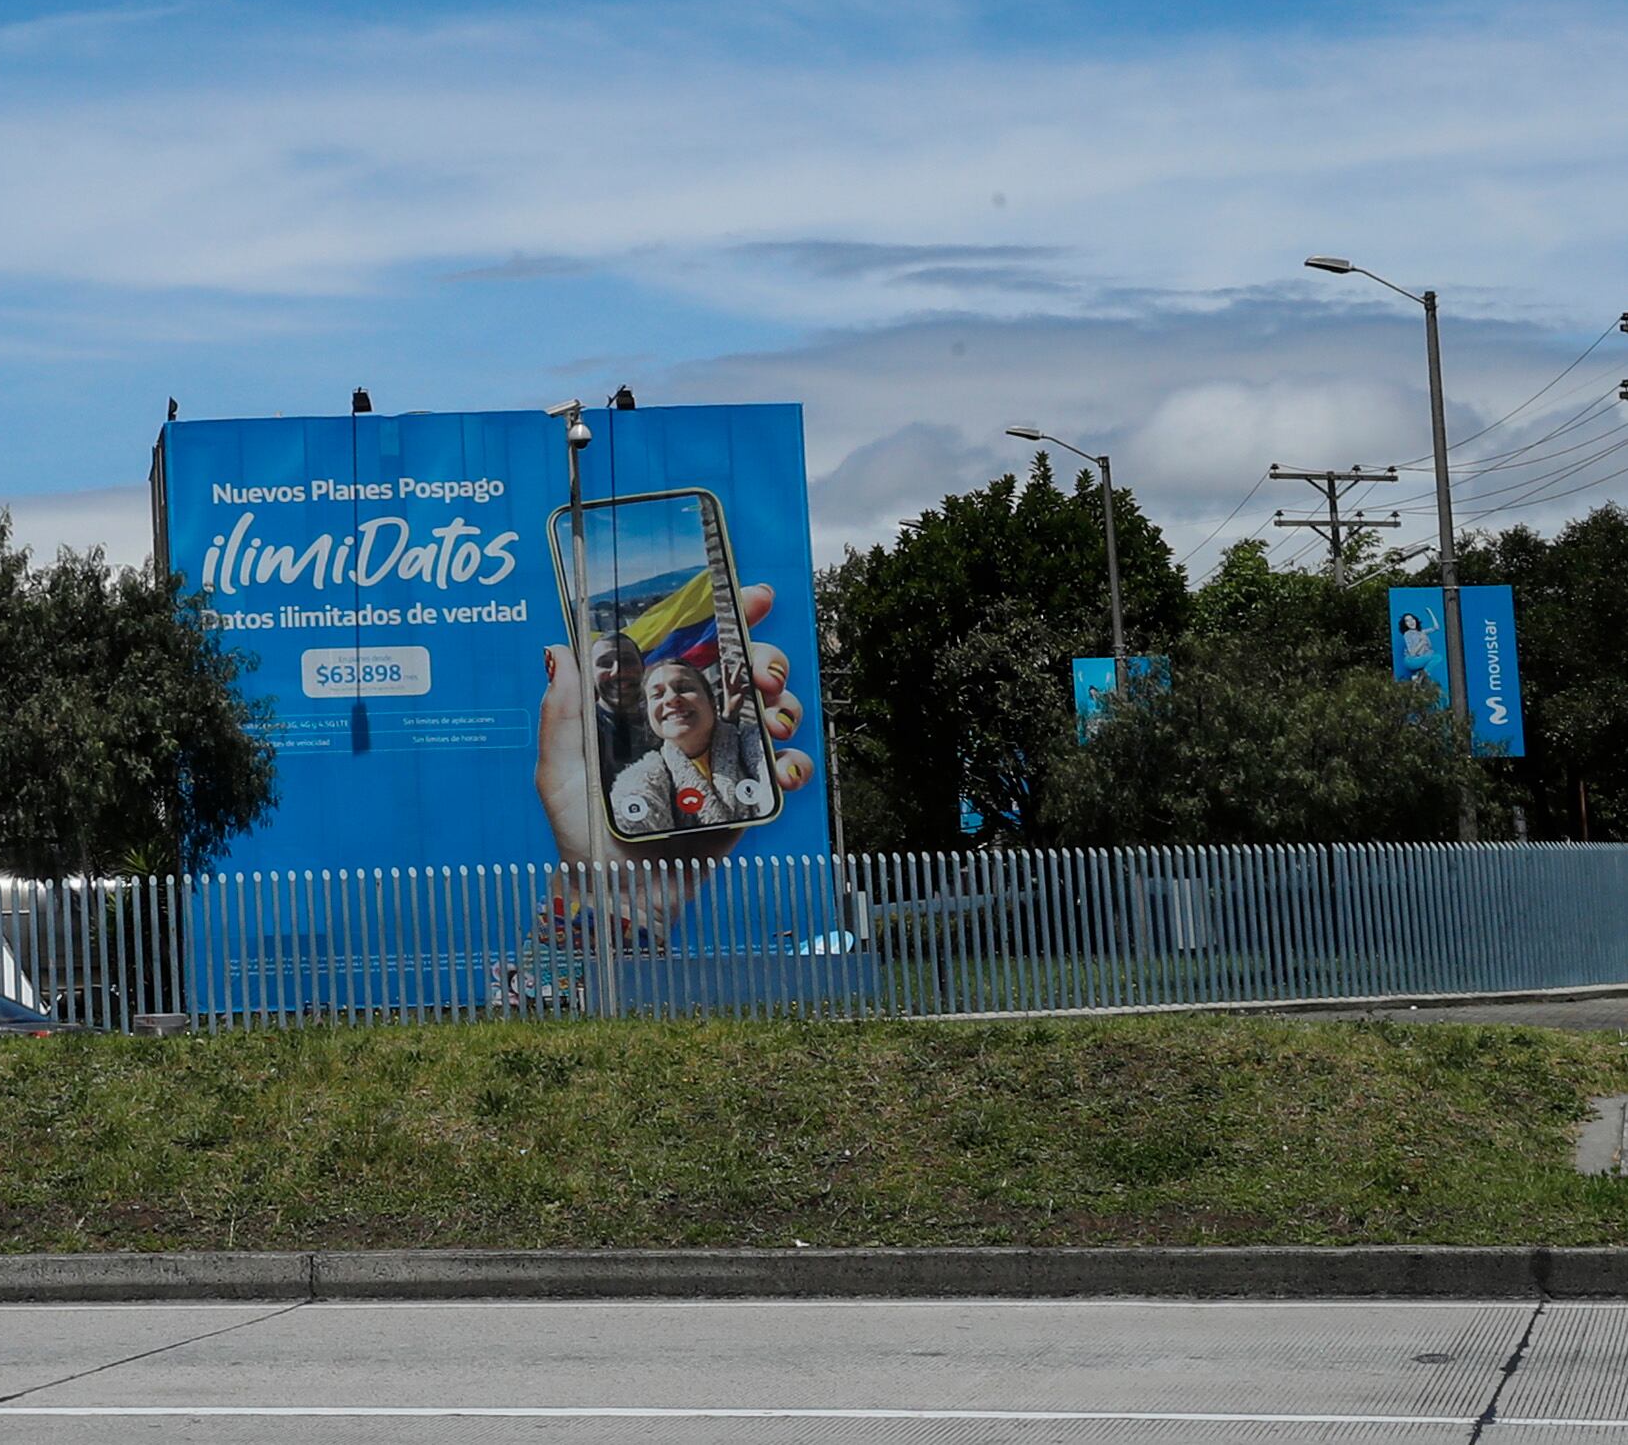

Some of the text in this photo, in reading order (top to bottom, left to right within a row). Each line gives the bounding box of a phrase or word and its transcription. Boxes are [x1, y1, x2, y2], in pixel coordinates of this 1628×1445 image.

[211, 477, 505, 504] Nuevos Planes Pospago
[202, 511, 519, 595] ilimiDatos
[200, 599, 527, 631] Datos ilimitados de verdad
[1484, 618, 1502, 691] movistar
[316, 664, 402, 686] $63.898
